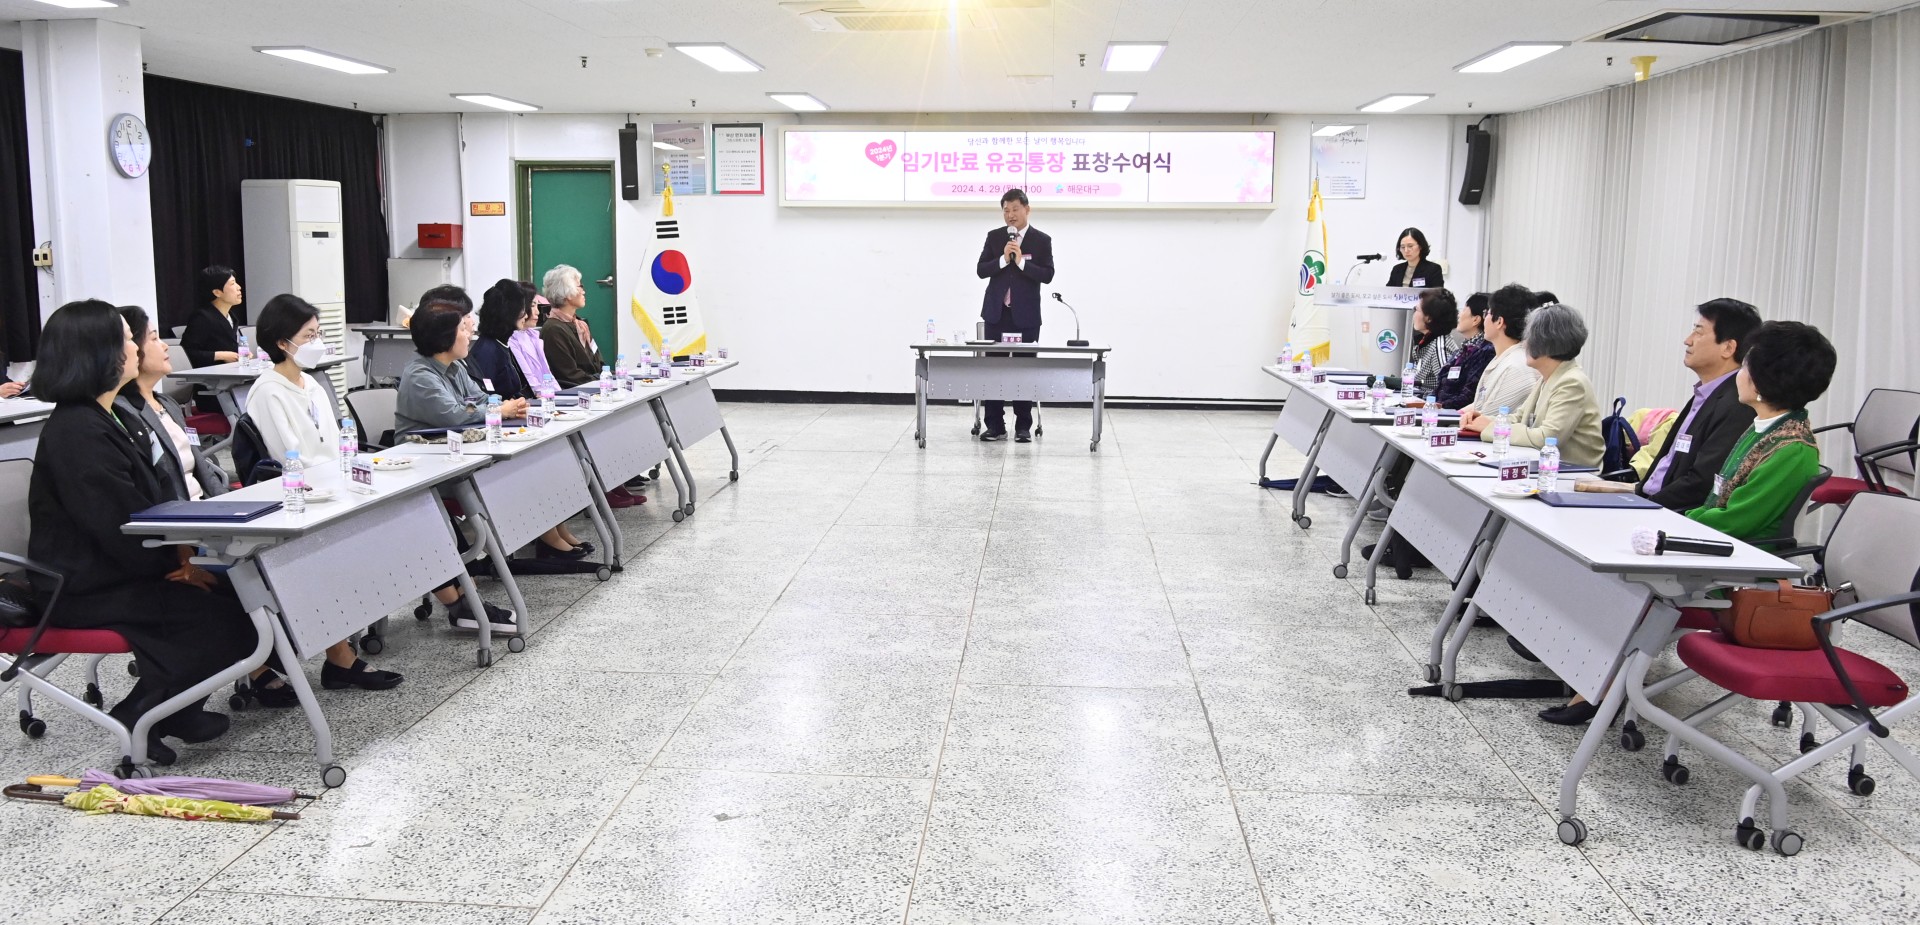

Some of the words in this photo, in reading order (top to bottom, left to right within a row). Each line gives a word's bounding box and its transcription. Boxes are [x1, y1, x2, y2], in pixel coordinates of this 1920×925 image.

[137, 131, 143, 140] 2
[967, 137, 989, 146] 당신과
[991, 137, 1013, 146] 함께한
[1033, 136, 1048, 145] 날이
[1050, 136, 1086, 146] 행복입니다
[869, 144, 893, 155] 2024년
[901, 151, 979, 173] 임기만료
[985, 152, 1066, 173] 유공통장
[1072, 151, 1171, 173] 표창수여식
[951, 184, 976, 193] 2024.
[979, 184, 987, 193] 4.
[1067, 184, 1100, 194] 해운대구
[1502, 466, 1528, 479] 박정숙
